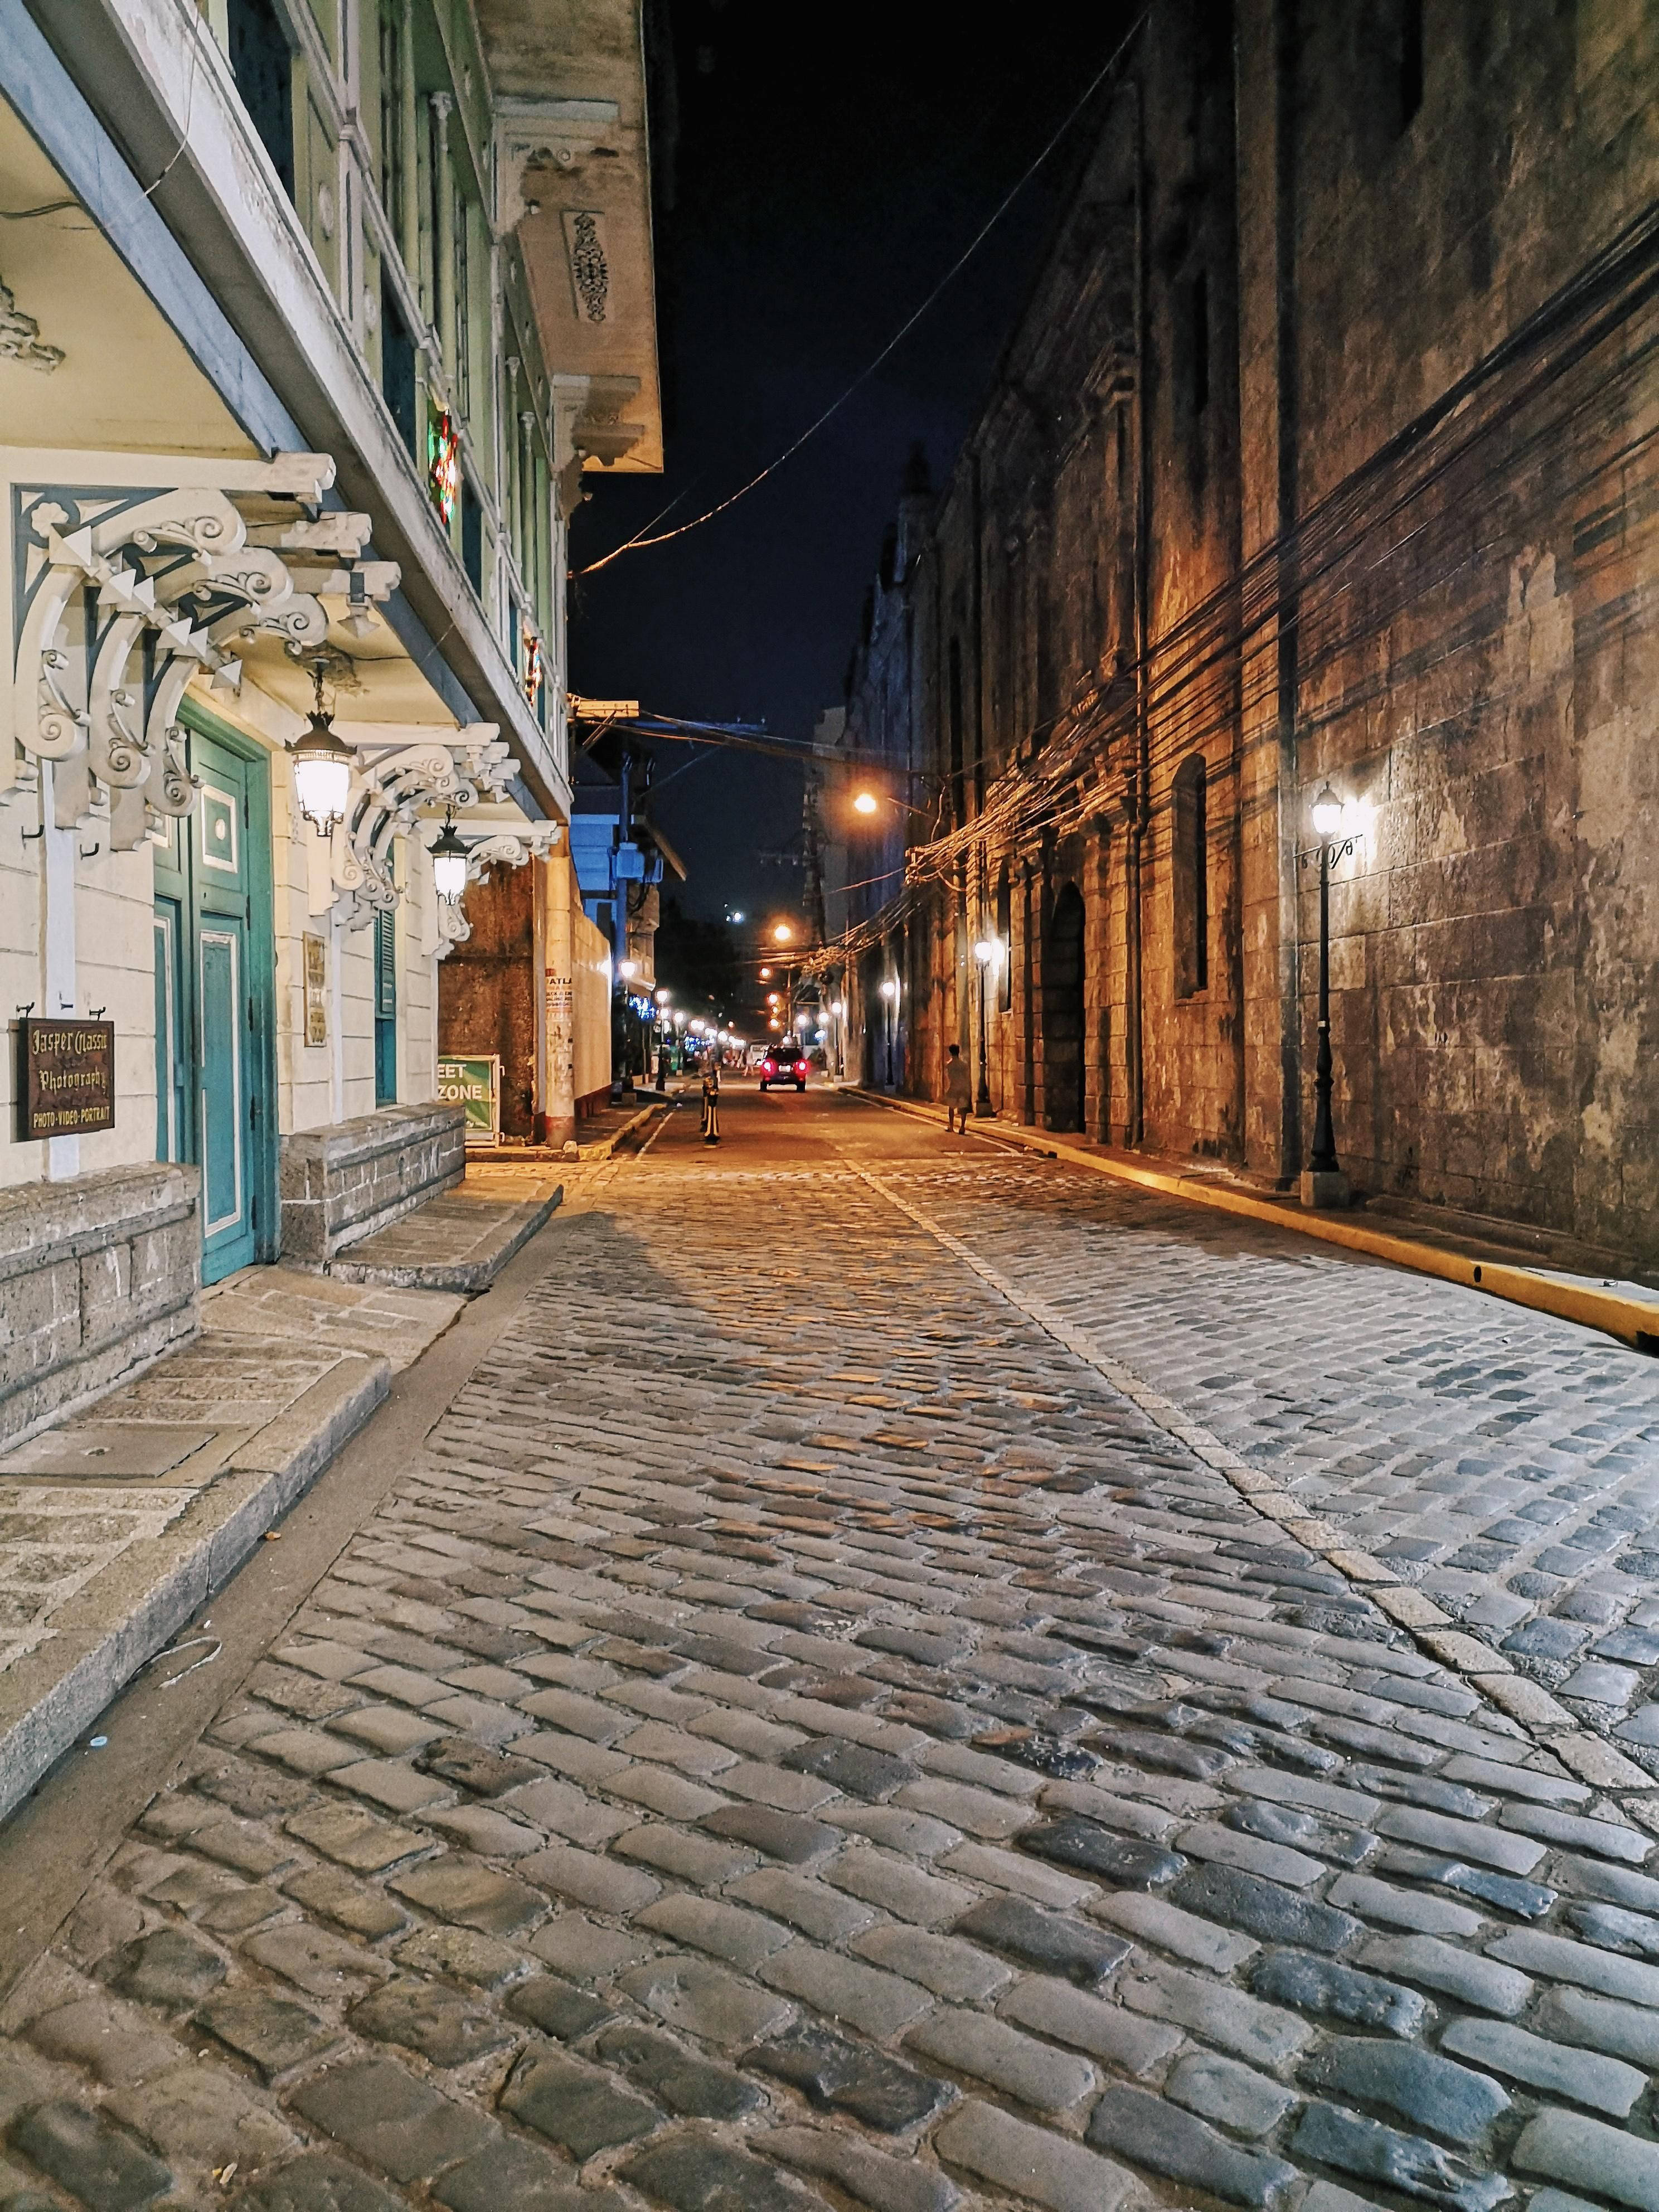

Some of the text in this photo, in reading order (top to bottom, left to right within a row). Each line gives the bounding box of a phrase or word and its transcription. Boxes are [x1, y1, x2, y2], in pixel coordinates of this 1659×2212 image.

[32, 1030, 74, 1057] Jasper
[38, 1065, 106, 1096] Photography
[438, 1084, 482, 1100] ZONE
